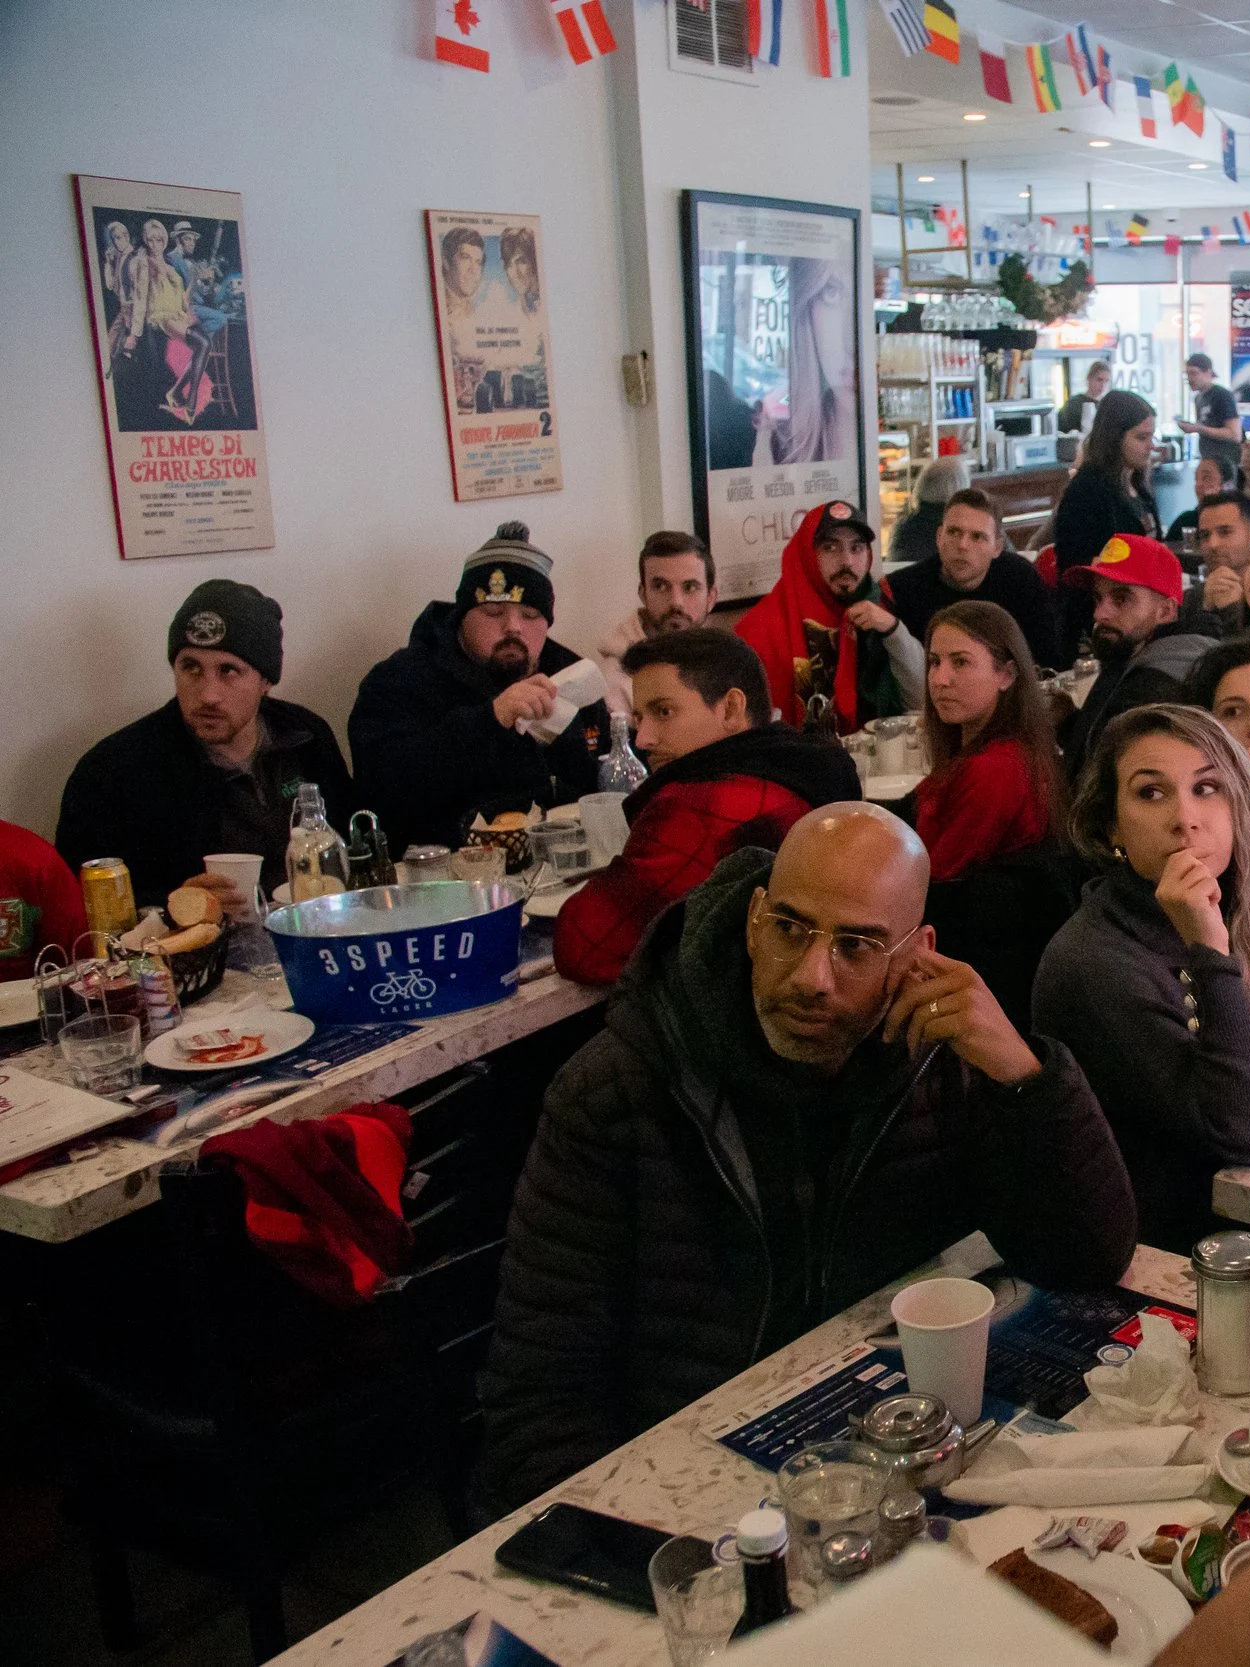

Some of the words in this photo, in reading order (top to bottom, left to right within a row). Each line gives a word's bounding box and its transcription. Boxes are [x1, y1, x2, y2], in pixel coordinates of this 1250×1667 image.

[539, 411, 552, 437] 2
[141, 434, 214, 458] TEMPO
[128, 457, 257, 483] CHARLESTON
[380, 1000, 433, 1015] LAGER
